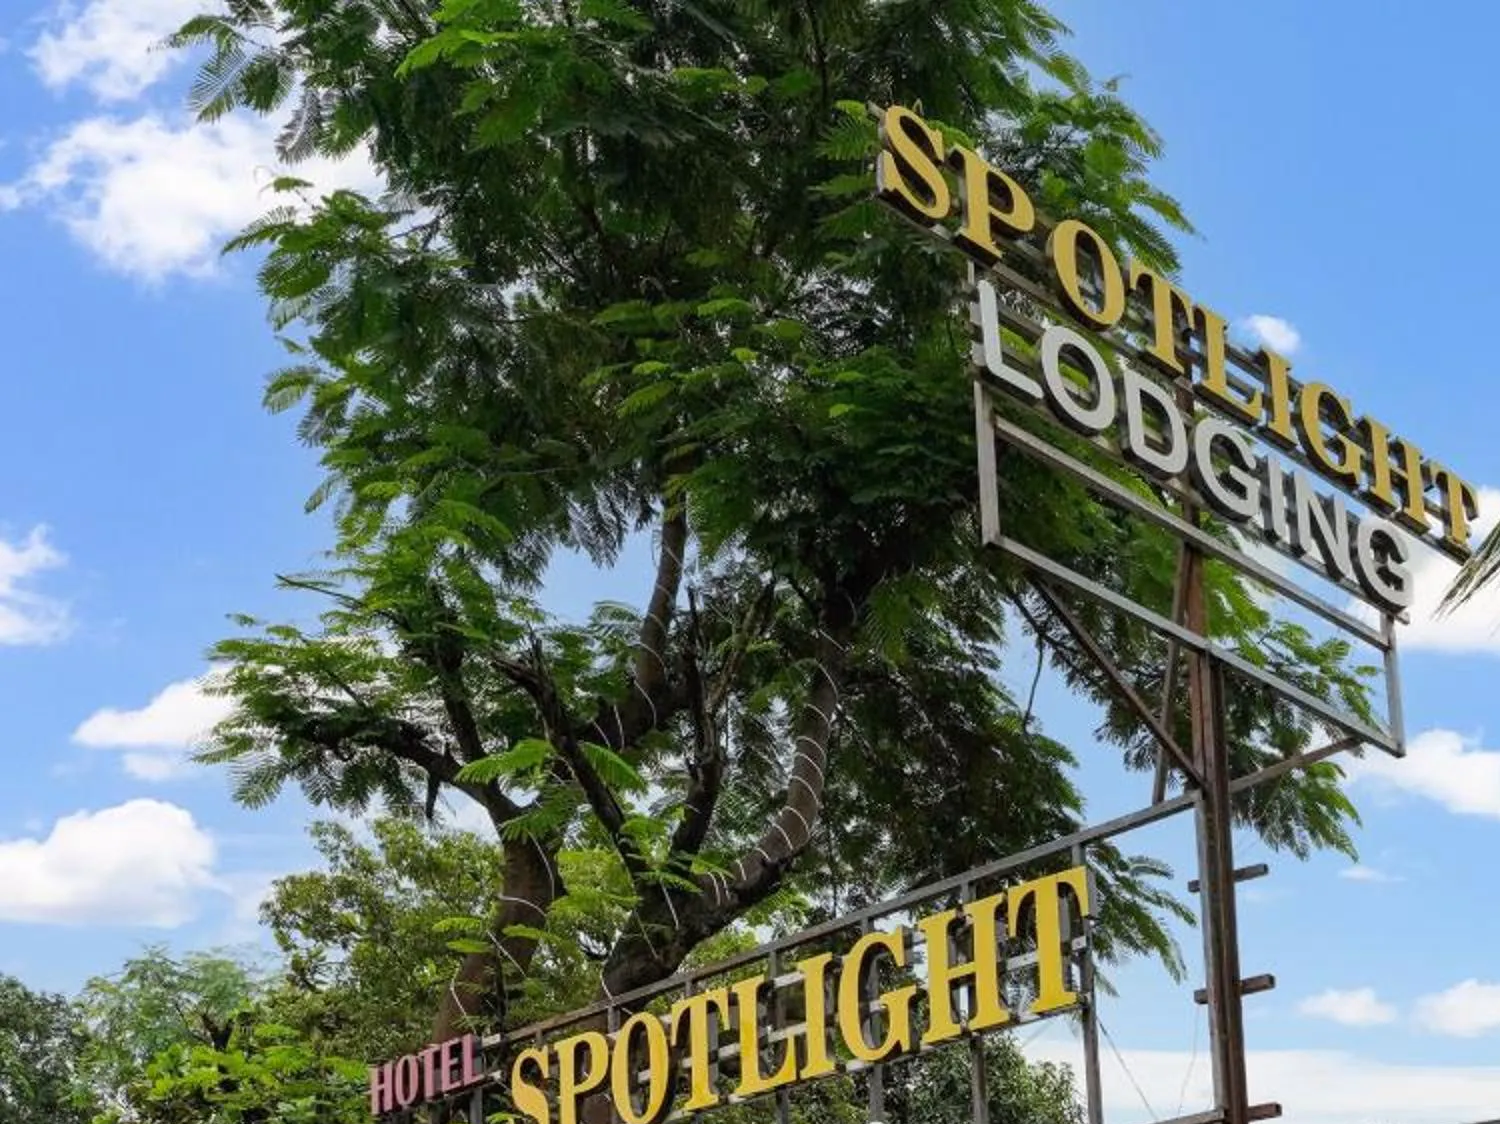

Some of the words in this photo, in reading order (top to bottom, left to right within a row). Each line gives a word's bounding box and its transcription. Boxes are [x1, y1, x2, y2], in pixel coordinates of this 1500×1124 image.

[879, 104, 1479, 558] SPOTLIGHT
[975, 278, 1415, 614] LODGING
[371, 1033, 484, 1115] HOTEL
